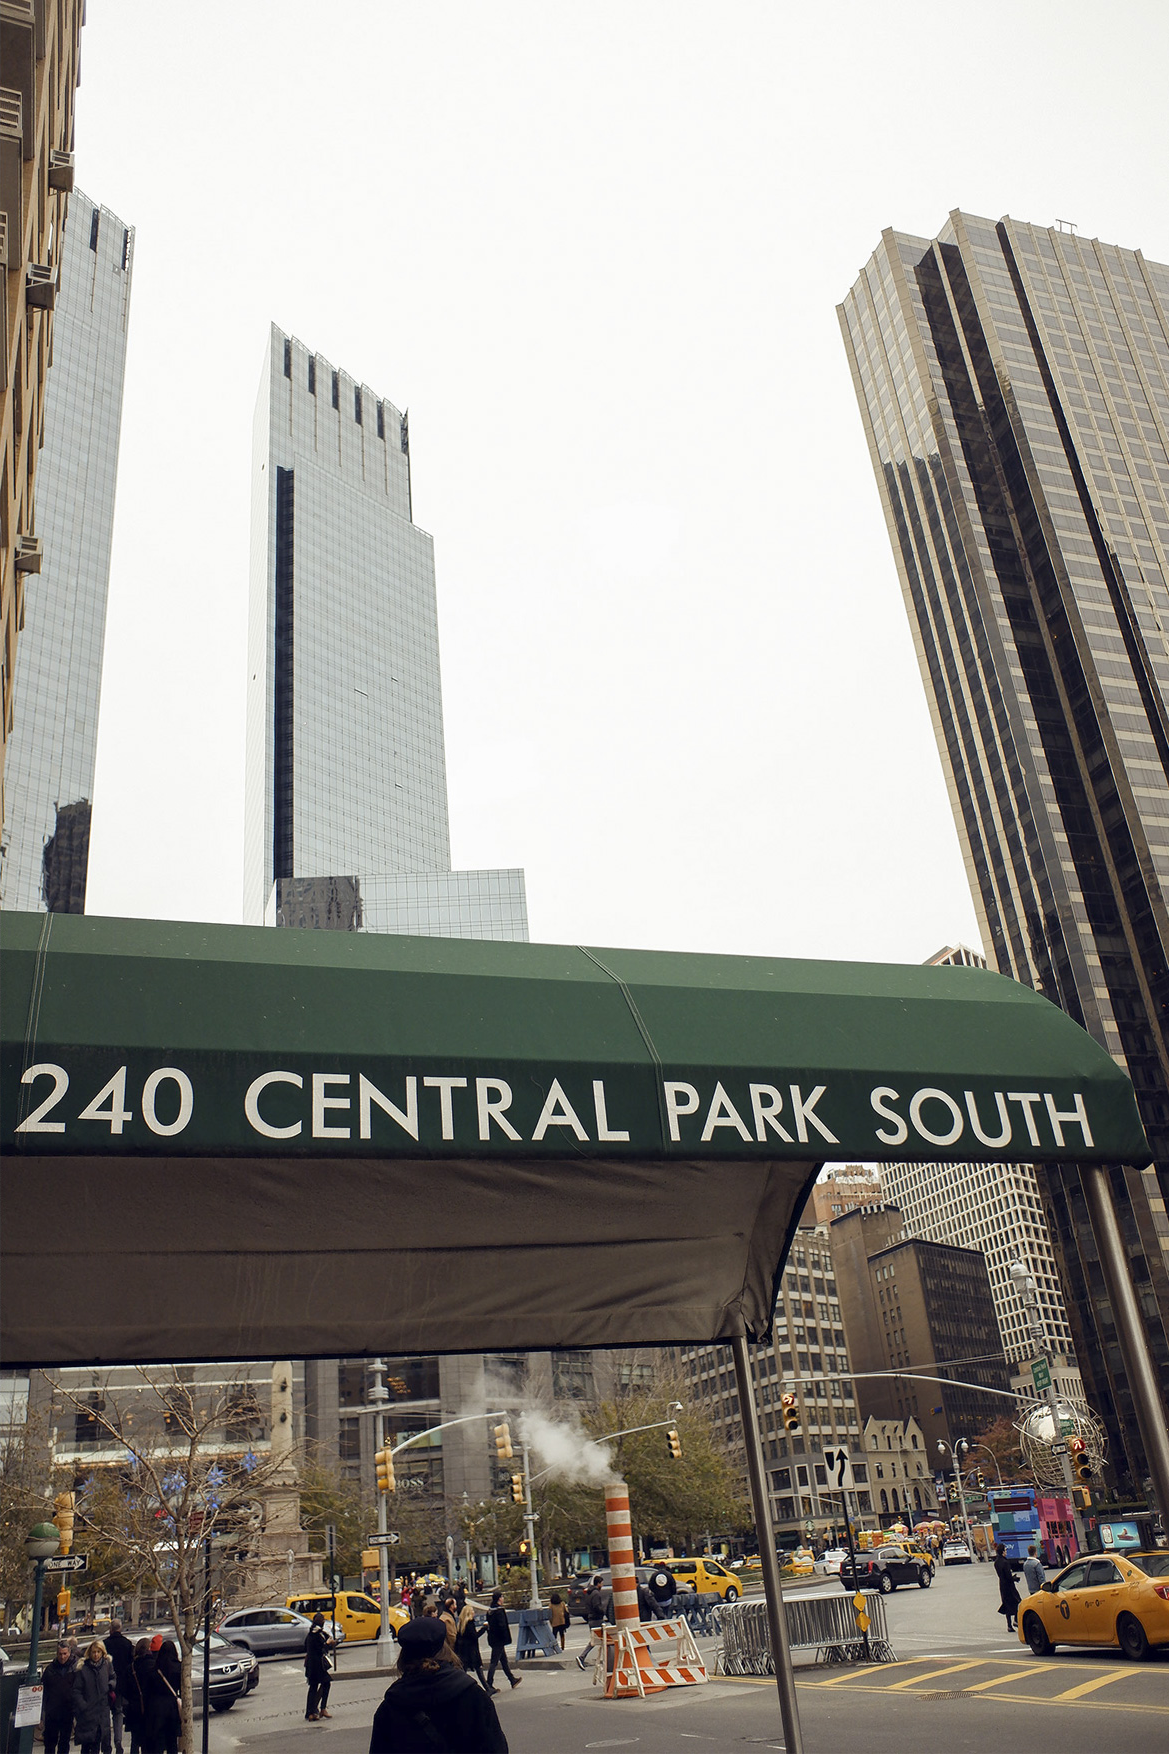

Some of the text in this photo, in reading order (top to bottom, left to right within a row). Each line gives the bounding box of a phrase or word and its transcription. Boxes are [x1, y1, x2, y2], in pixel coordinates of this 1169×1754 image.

[14, 1063, 1094, 1148] 240 CENTRAL PARK SOUTH
[395, 1477, 424, 1489] BOSS
